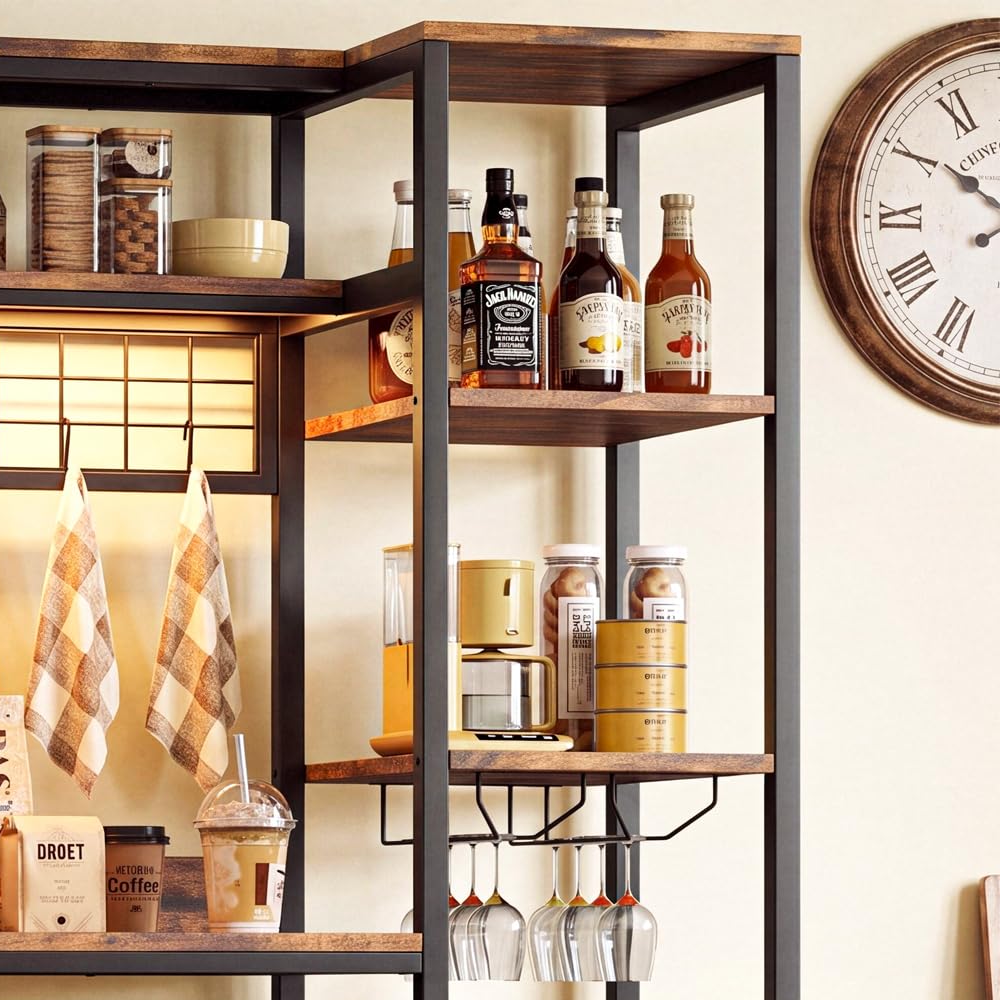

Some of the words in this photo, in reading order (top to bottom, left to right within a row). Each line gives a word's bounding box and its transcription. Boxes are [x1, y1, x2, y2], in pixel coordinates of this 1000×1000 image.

[934, 88, 980, 140] XI
[890, 137, 939, 178] X
[879, 201, 922, 232] IX
[886, 250, 940, 308] VIII
[933, 296, 976, 353] VII
[37, 843, 85, 861] DROET
[108, 877, 159, 893] Coffee
